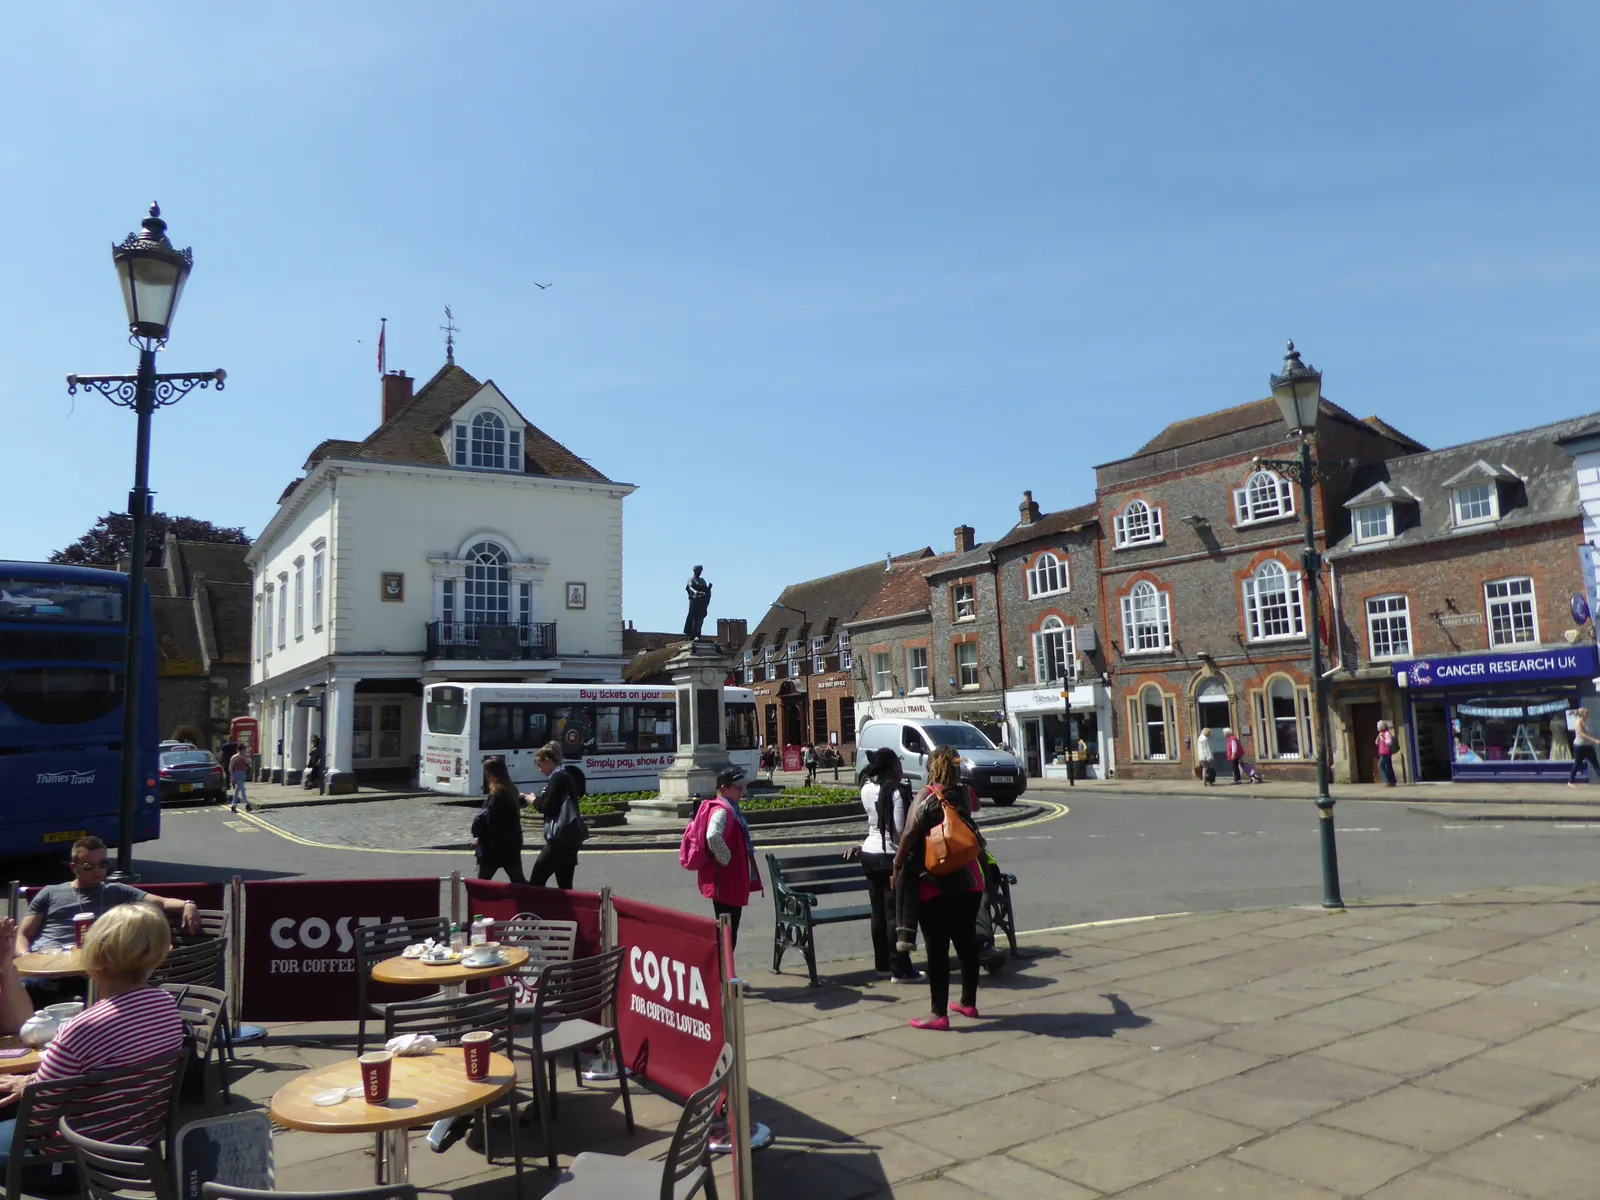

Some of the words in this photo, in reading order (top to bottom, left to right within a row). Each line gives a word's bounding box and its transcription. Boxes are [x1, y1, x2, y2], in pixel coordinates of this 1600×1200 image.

[1436, 662, 1485, 678] CANCER
[1489, 656, 1554, 674] RESEARCH
[1557, 655, 1577, 669] UK
[580, 689, 597, 700] Buy
[599, 690, 627, 699] tickets
[629, 691, 640, 699] on
[641, 691, 660, 700] your
[884, 706, 907, 714] TRIANGLE
[907, 704, 927, 713] TRAVEL
[586, 758, 615, 769] Simply
[617, 758, 635, 768] pay,
[636, 756, 658, 766] show
[658, 756, 665, 764] &
[36, 773, 69, 784] Thames
[70, 774, 95, 785] Travel
[270, 959, 300, 973] FOR
[302, 958, 355, 973] COFFEE
[630, 945, 710, 1010] COSTA
[630, 993, 646, 1015] FOR
[646, 1000, 676, 1028] COFFEE
[675, 1012, 712, 1042] LOVERS
[370, 1069, 378, 1097] COSTA
[190, 1169, 198, 1198] COSTA
